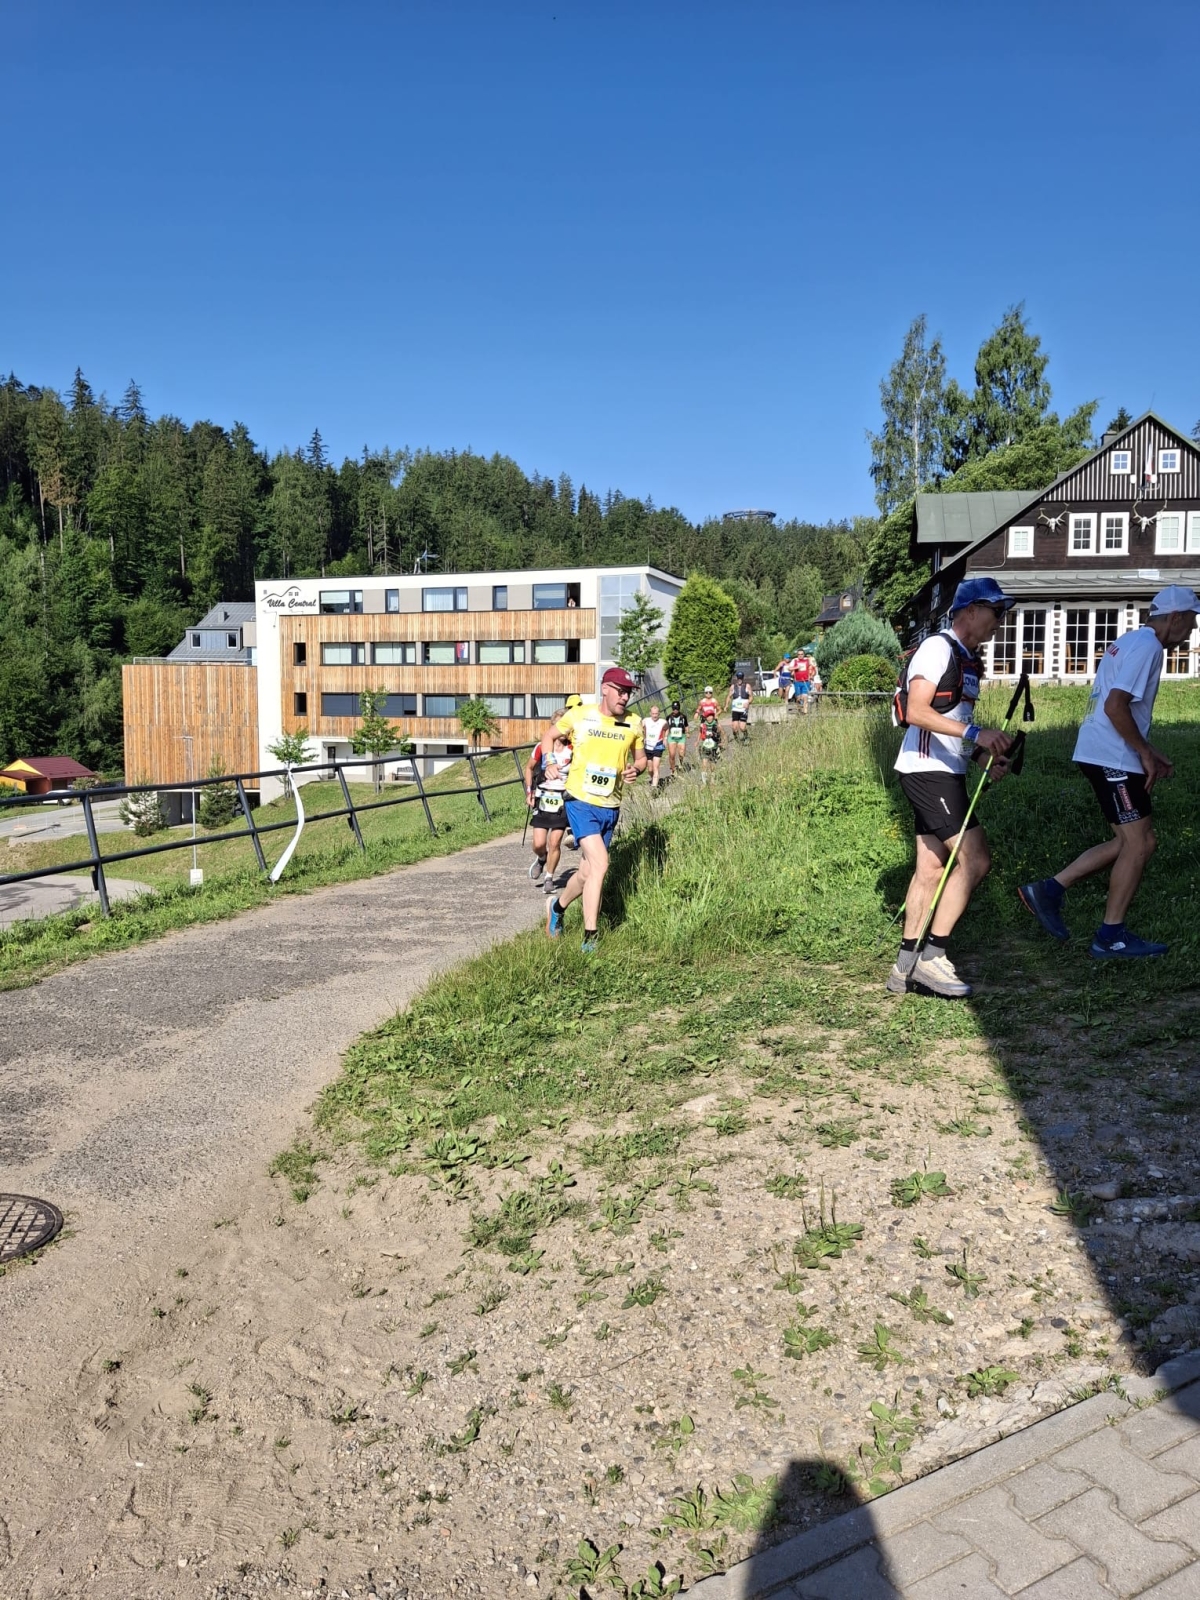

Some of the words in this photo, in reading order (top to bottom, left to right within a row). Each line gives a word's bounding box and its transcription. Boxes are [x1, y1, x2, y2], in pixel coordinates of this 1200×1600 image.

[267, 598, 285, 607] Villa
[288, 598, 316, 608] Central
[588, 729, 626, 741] SWEDEN
[591, 774, 609, 786] 989
[545, 798, 559, 806] 463
